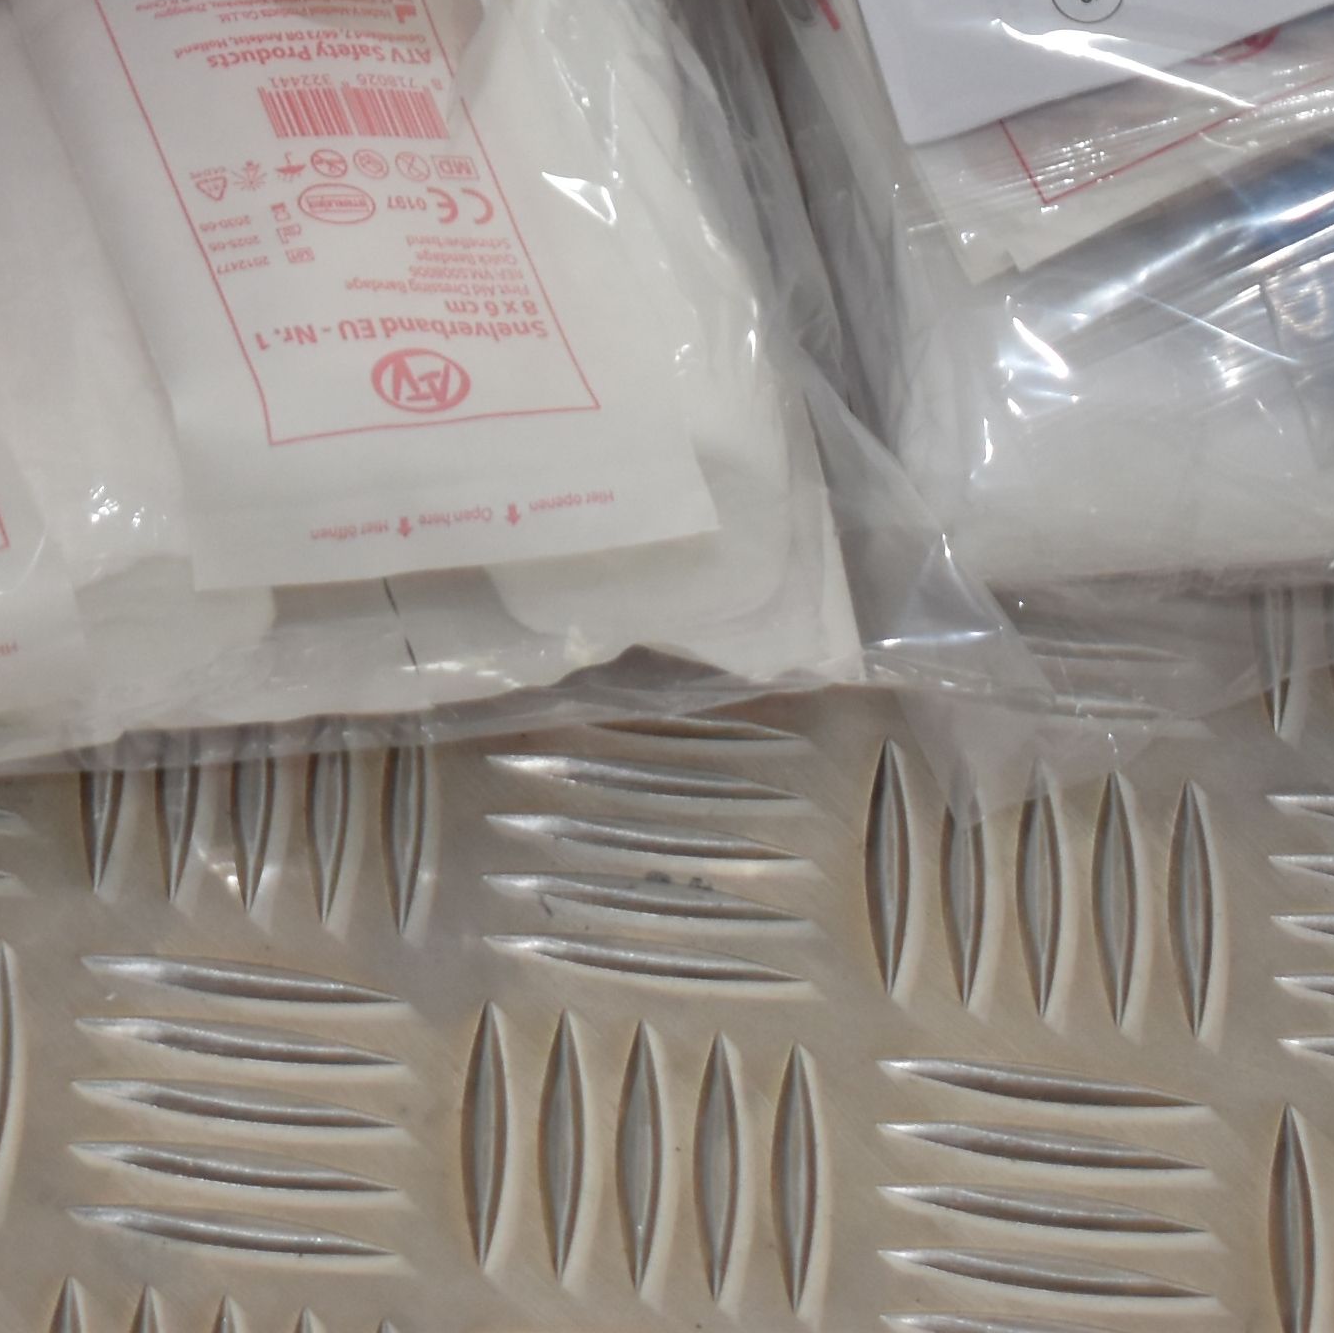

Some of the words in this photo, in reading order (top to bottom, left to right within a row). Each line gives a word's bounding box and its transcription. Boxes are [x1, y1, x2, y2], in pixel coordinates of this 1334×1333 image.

[208, 47, 312, 68] Products
[316, 41, 385, 61] Safety
[390, 47, 431, 64] ATV
[270, 74, 329, 91] 322441
[435, 156, 473, 175] MD
[387, 195, 427, 209] 0197
[469, 282, 498, 297] Aid
[498, 284, 530, 296] First
[444, 300, 479, 313] cm
[482, 298, 502, 317] 6
[520, 298, 540, 316] 8
[274, 325, 317, 345] Nr.
[338, 318, 376, 340] EU
[381, 318, 546, 339] Snelverband
[255, 332, 270, 350] 1
[389, 352, 453, 405] ATV
[586, 491, 615, 504] Hier
[450, 504, 496, 525] Open
